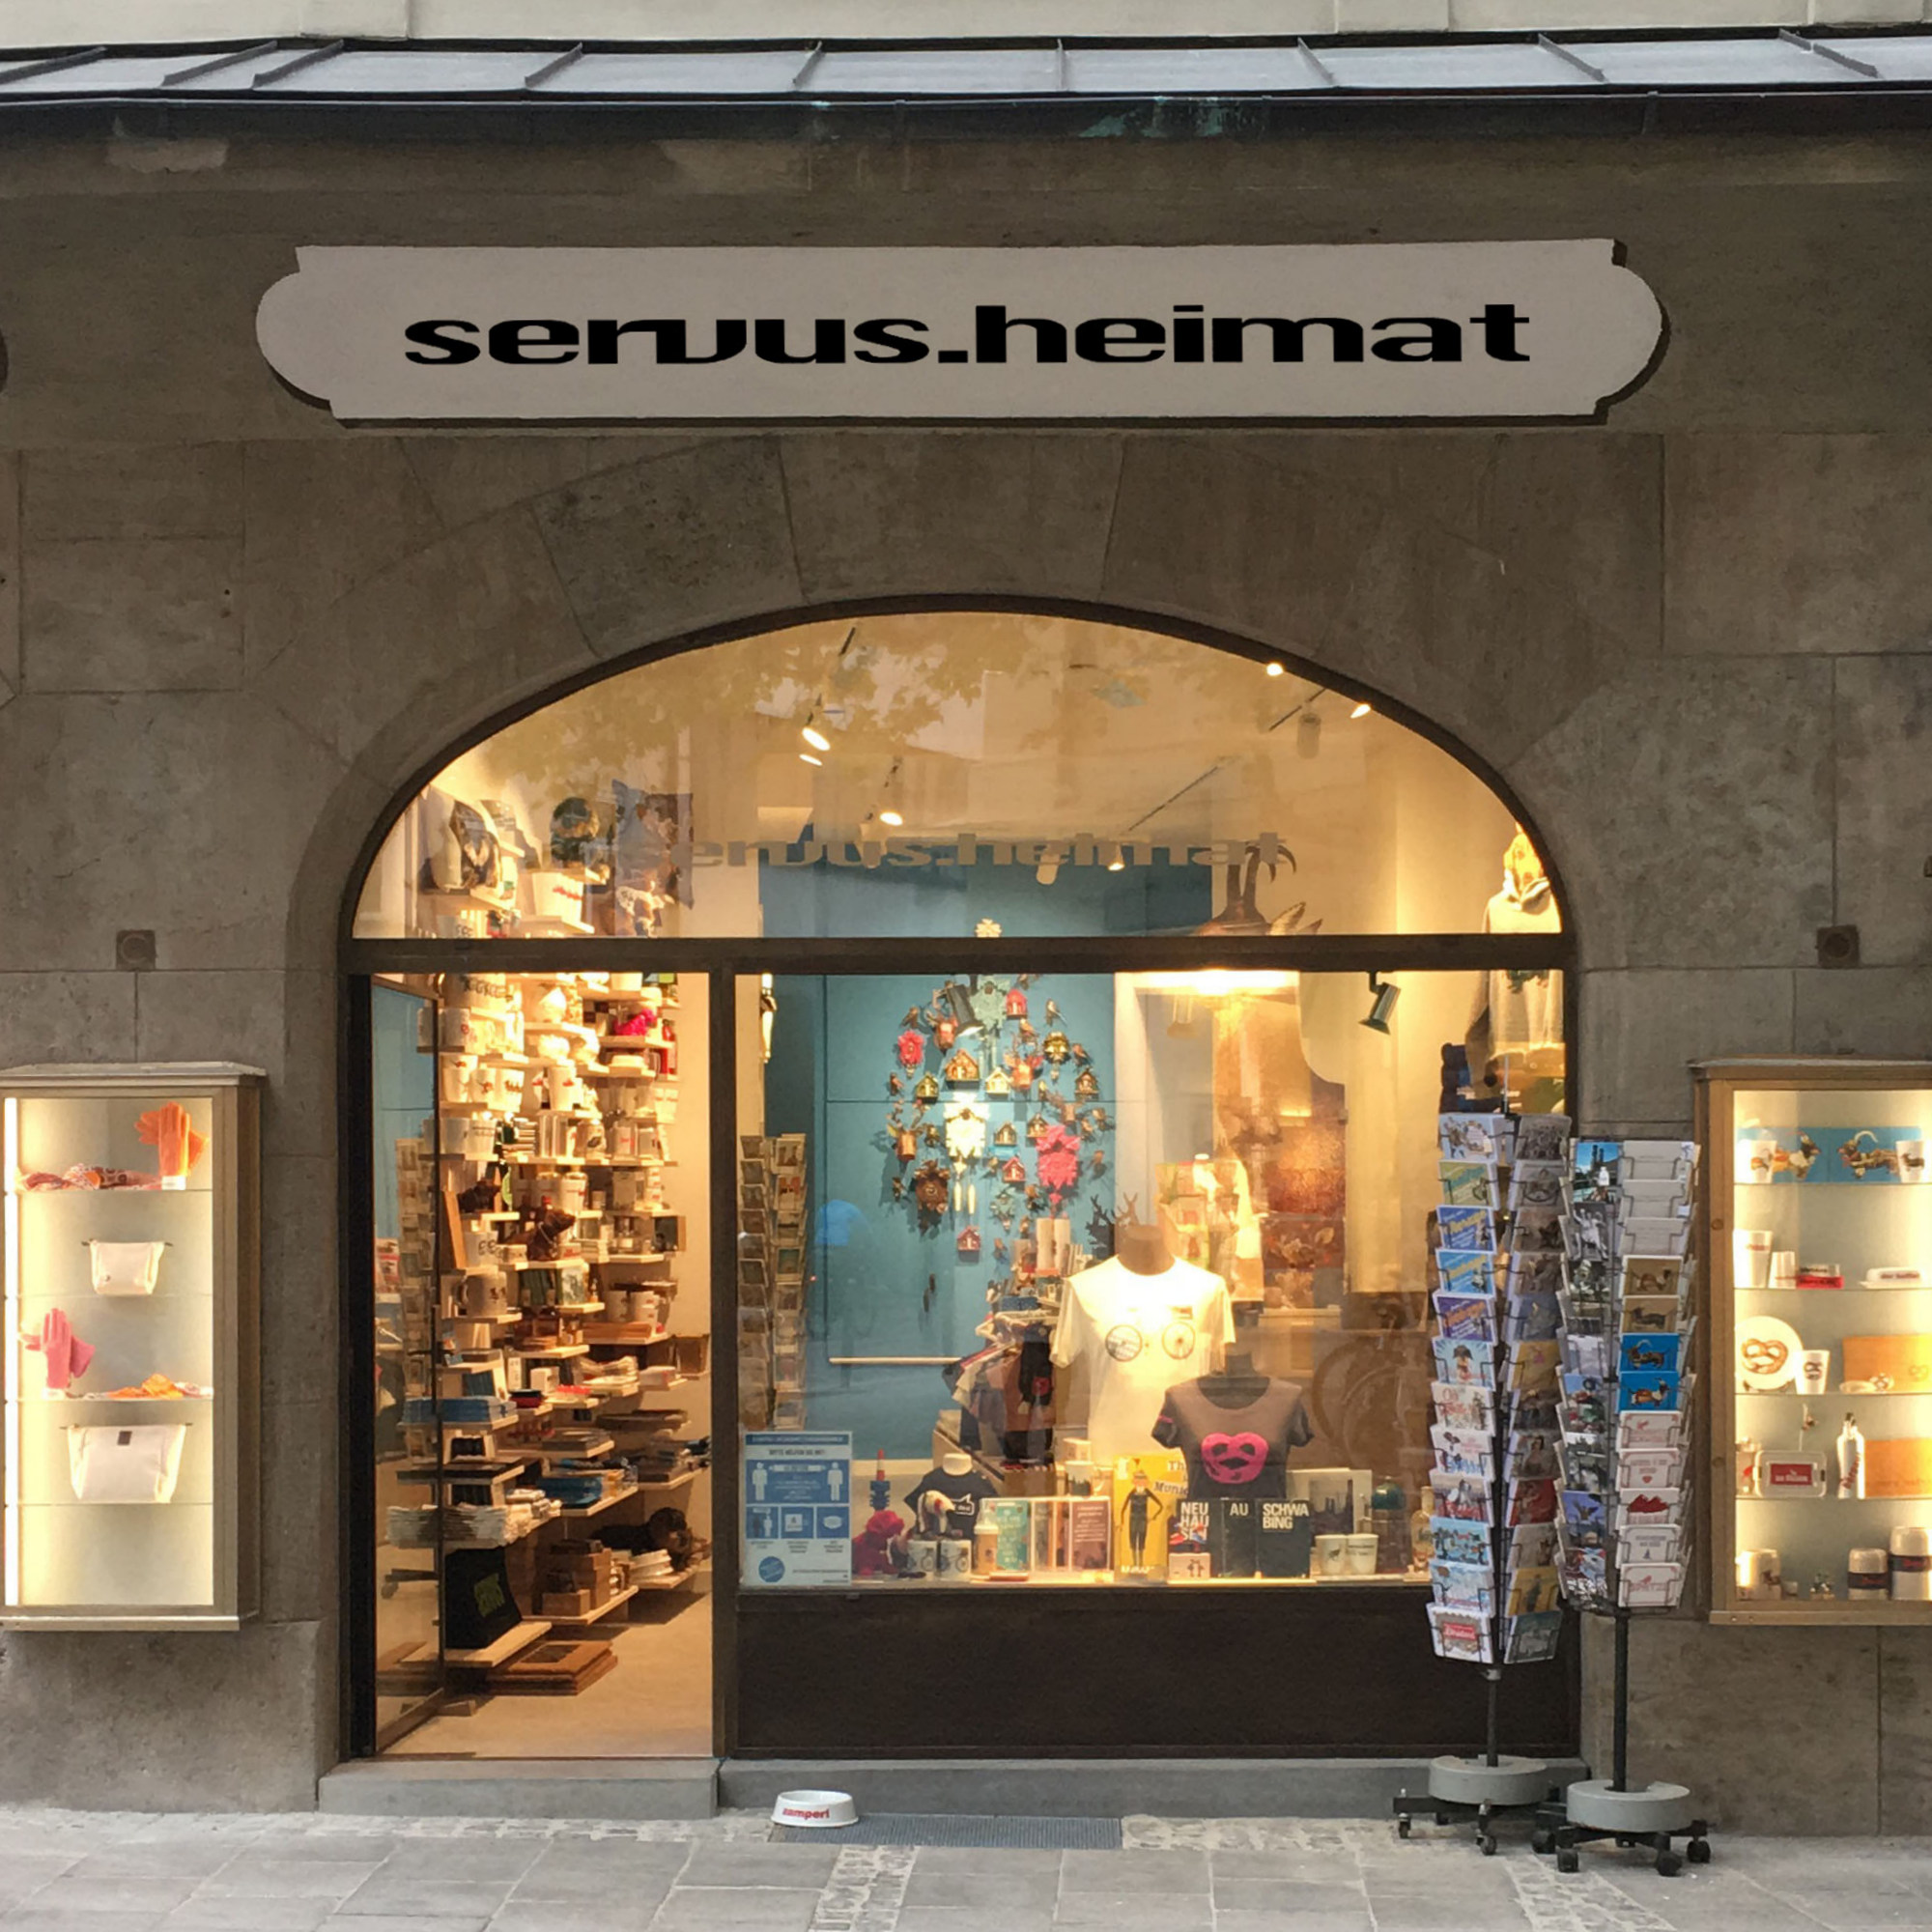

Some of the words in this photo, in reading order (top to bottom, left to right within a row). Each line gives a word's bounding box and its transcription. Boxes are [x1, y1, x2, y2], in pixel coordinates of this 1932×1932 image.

[404, 303, 1530, 365] servus.heimat
[1153, 1481, 1189, 1495] Munic
[1180, 1502, 1209, 1516] NEU
[1230, 1503, 1249, 1516] AU
[1263, 1503, 1309, 1517] SCHWA
[1179, 1516, 1209, 1528] HAU
[1263, 1517, 1293, 1529] BING
